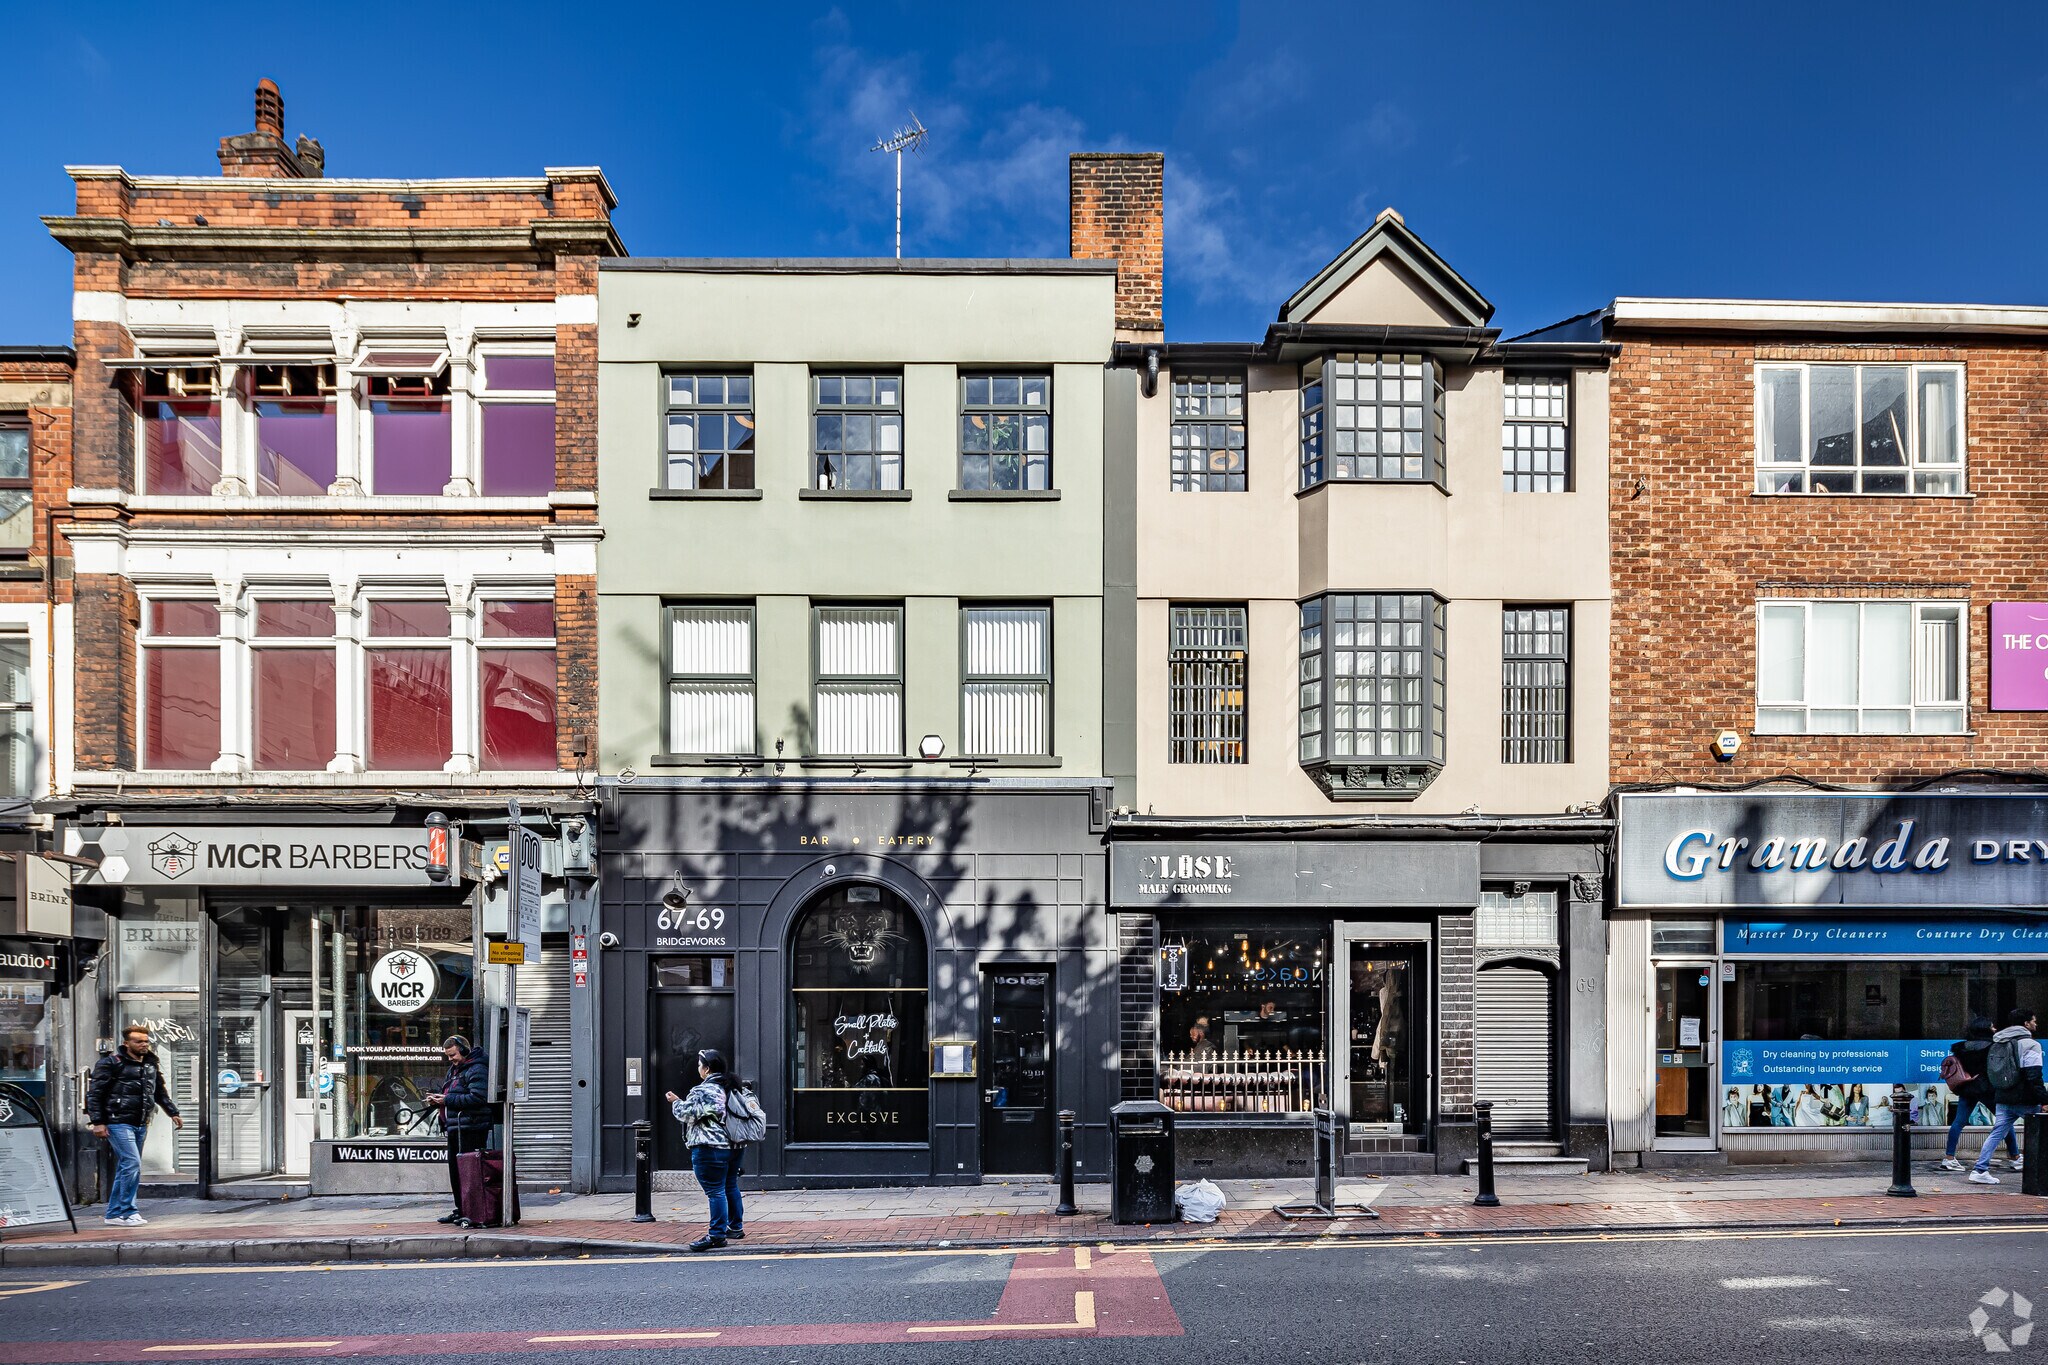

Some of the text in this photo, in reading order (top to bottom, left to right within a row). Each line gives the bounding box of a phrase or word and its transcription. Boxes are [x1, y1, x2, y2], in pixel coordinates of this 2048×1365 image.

[2003, 634, 2032, 649] THE
[800, 836, 934, 845] BAR EATERY
[207, 844, 428, 869] MCR BARBERS
[1664, 818, 1950, 881] Granada
[1138, 884, 1232, 894] MALE GROOMING
[1514, 882, 1530, 894] 69
[30, 891, 69, 905] BRINK
[657, 908, 725, 930] 67-69
[125, 928, 198, 942] BRINK
[351, 926, 384, 940] 0161
[417, 926, 451, 940] 5189
[1737, 928, 1888, 942] Master Dry Cleaners
[1916, 929, 1973, 939] Couture
[1980, 928, 2005, 942] Dry
[656, 938, 726, 946] BRIDGEWORKS
[381, 982, 425, 998] MCR
[1577, 977, 1596, 993] 69
[834, 1014, 898, 1035] Small Plates
[847, 1040, 888, 1058] Cocktails
[1763, 1050, 1889, 1060] Dry cleaning by professionals
[1920, 1050, 1945, 1058] Shirts
[1763, 1064, 1882, 1074] Outstanding laundry service
[827, 1112, 899, 1123] EXCLSVE
[338, 1147, 373, 1160] WALK
[375, 1147, 394, 1160] INS
